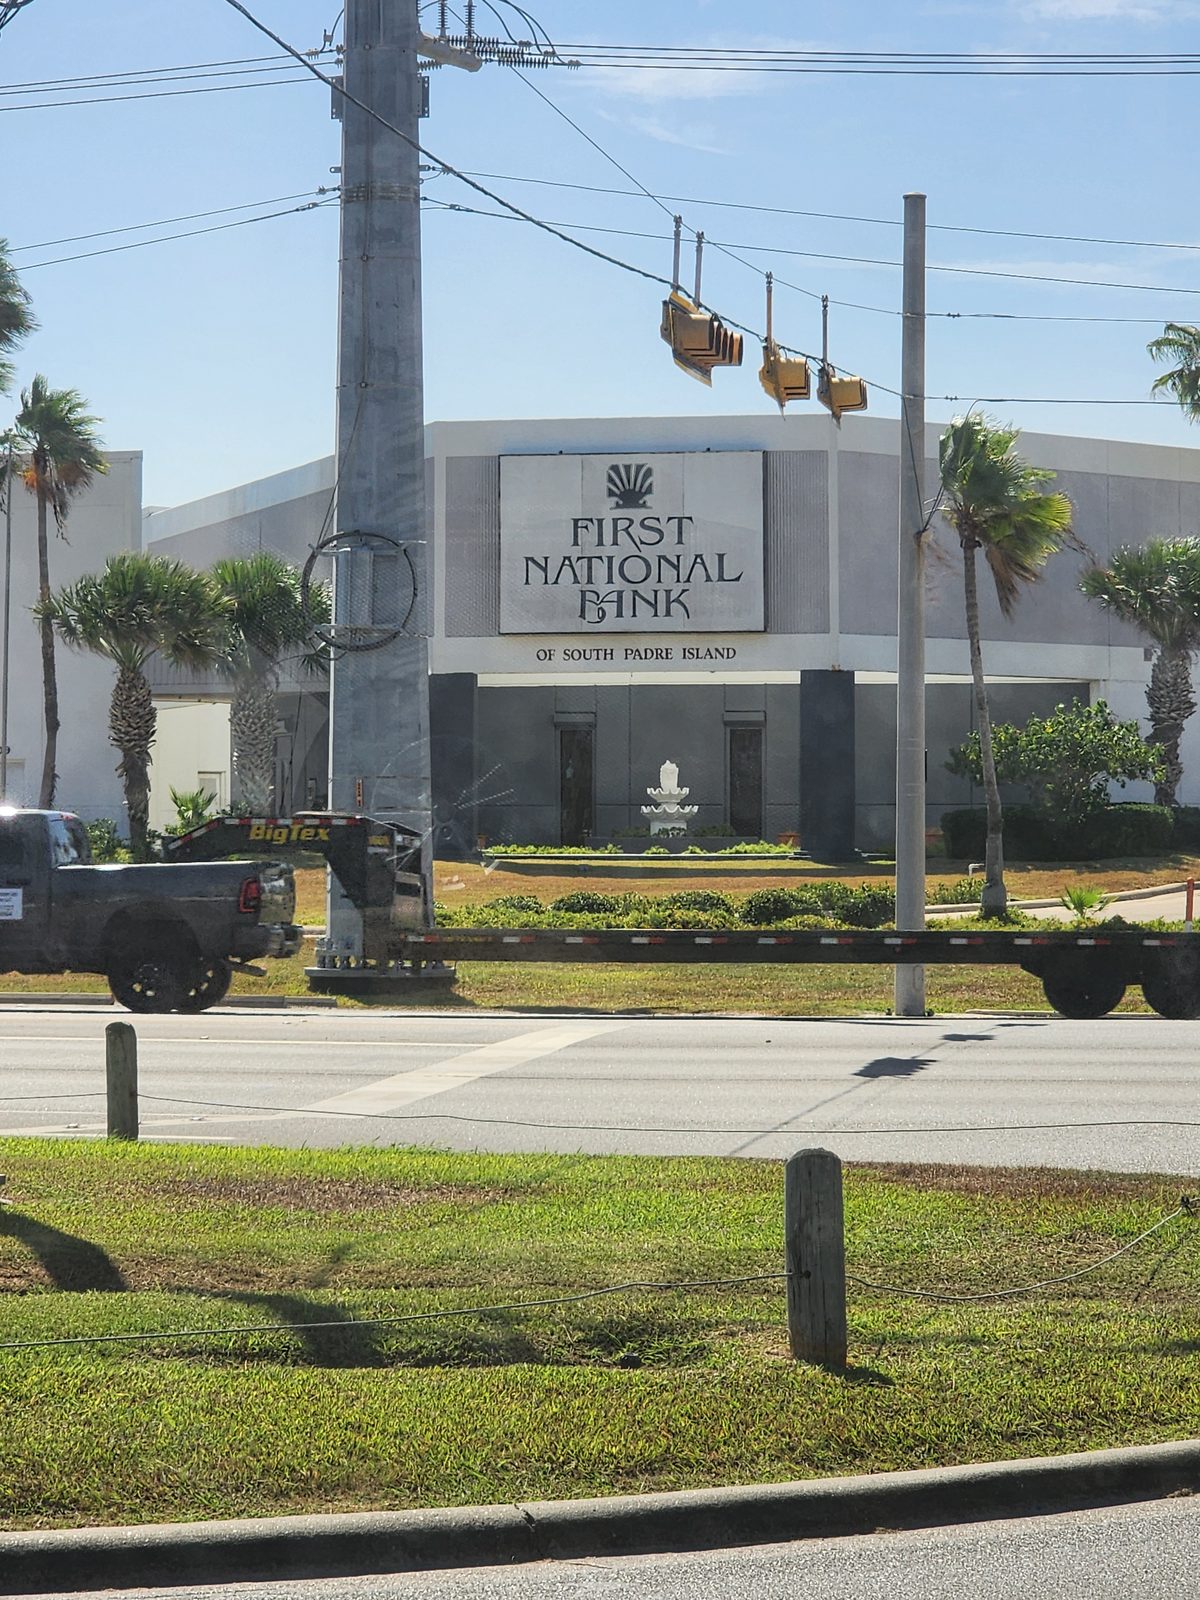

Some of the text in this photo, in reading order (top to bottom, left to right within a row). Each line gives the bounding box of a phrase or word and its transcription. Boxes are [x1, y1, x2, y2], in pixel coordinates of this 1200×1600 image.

[570, 516, 694, 553] FIRST
[523, 553, 744, 586] NATIONAL
[578, 588, 690, 624] BANK
[536, 647, 737, 661] OF SOUTH PADRE ISLAND
